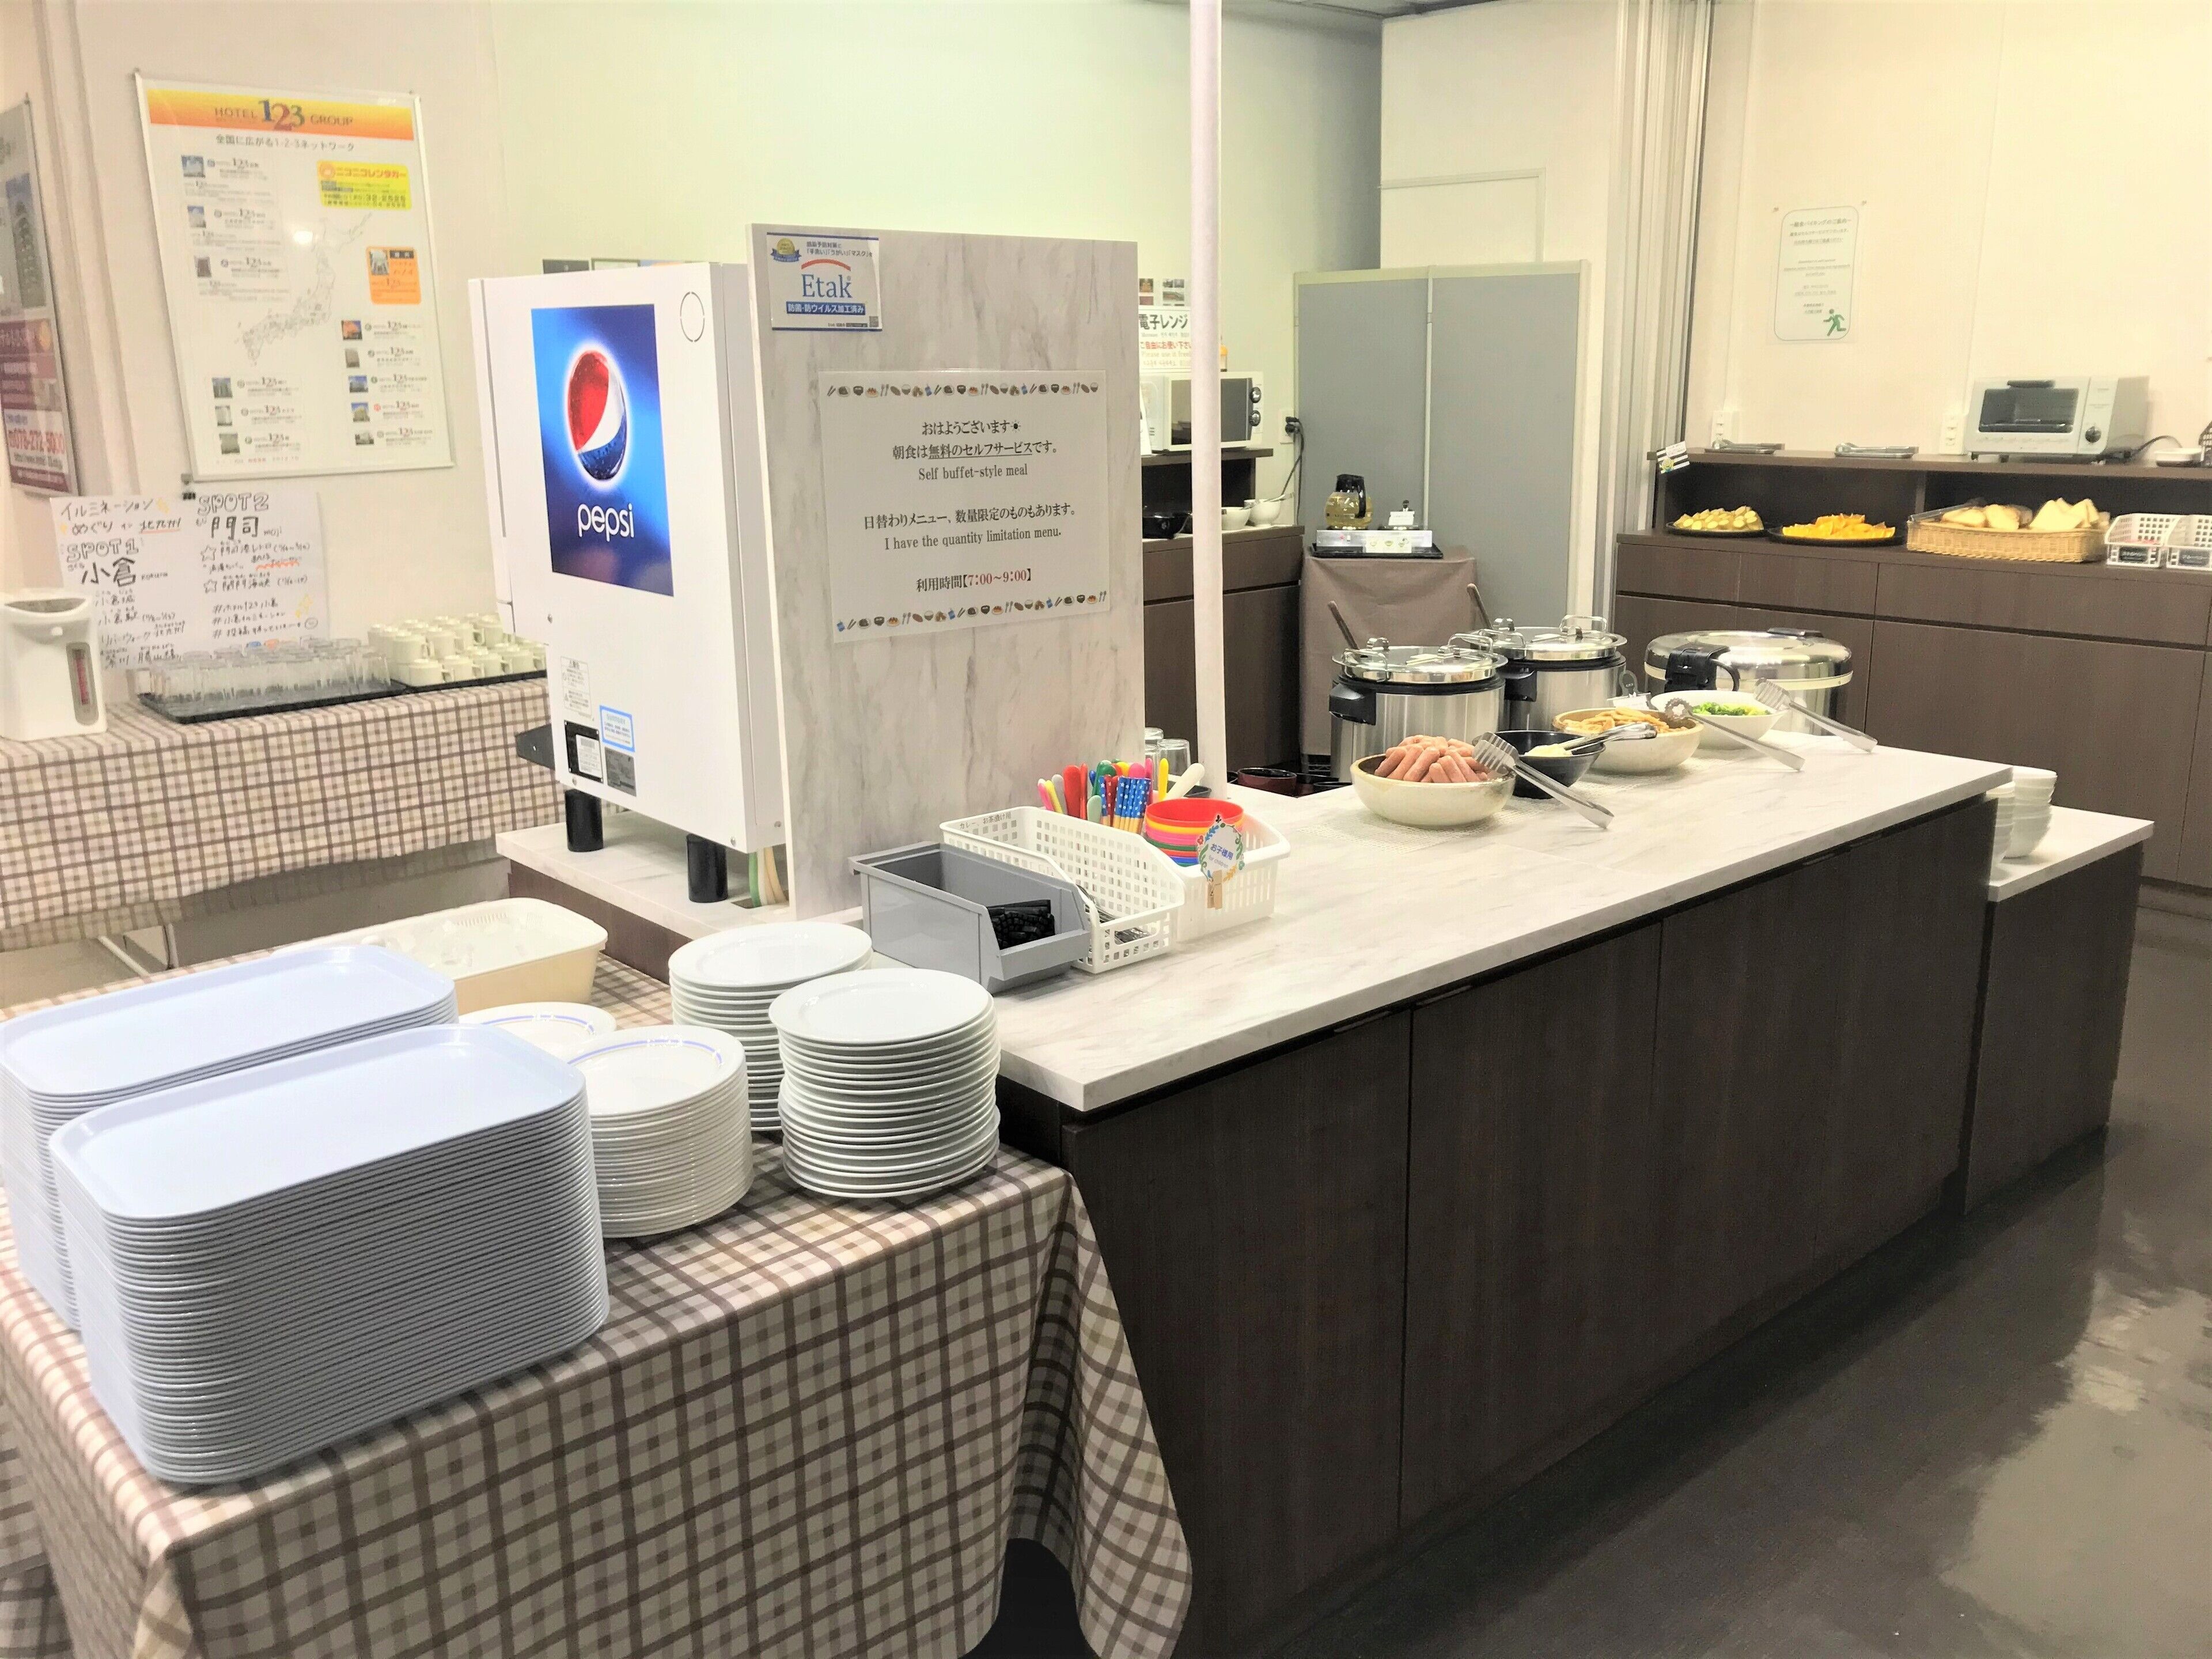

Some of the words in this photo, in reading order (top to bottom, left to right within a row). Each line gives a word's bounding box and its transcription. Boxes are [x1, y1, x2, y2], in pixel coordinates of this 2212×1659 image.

[215, 107, 257, 118] HOTEL
[258, 99, 305, 131] 123
[310, 114, 354, 126] GROUP
[801, 274, 853, 298] Etak
[1138, 313, 1188, 330] 電子レンジ
[922, 420, 1010, 436] おはようございます
[892, 440, 1058, 460] 朝食は無料のセルフサービスです。
[918, 467, 938, 480] Self
[942, 465, 1003, 480] buffet-style
[1006, 464, 1028, 476] meal
[211, 516, 259, 540] 門司
[577, 503, 634, 542] pepsi
[864, 502, 1076, 530] 日替わりメニュー、数量限定のものもあります。
[885, 538, 889, 550] I
[893, 536, 918, 549] have
[922, 535, 938, 547] the
[942, 532, 983, 546] quantity
[986, 528, 1031, 543] limitation
[1033, 525, 1062, 538] menu.
[81, 557, 137, 587] 小倉
